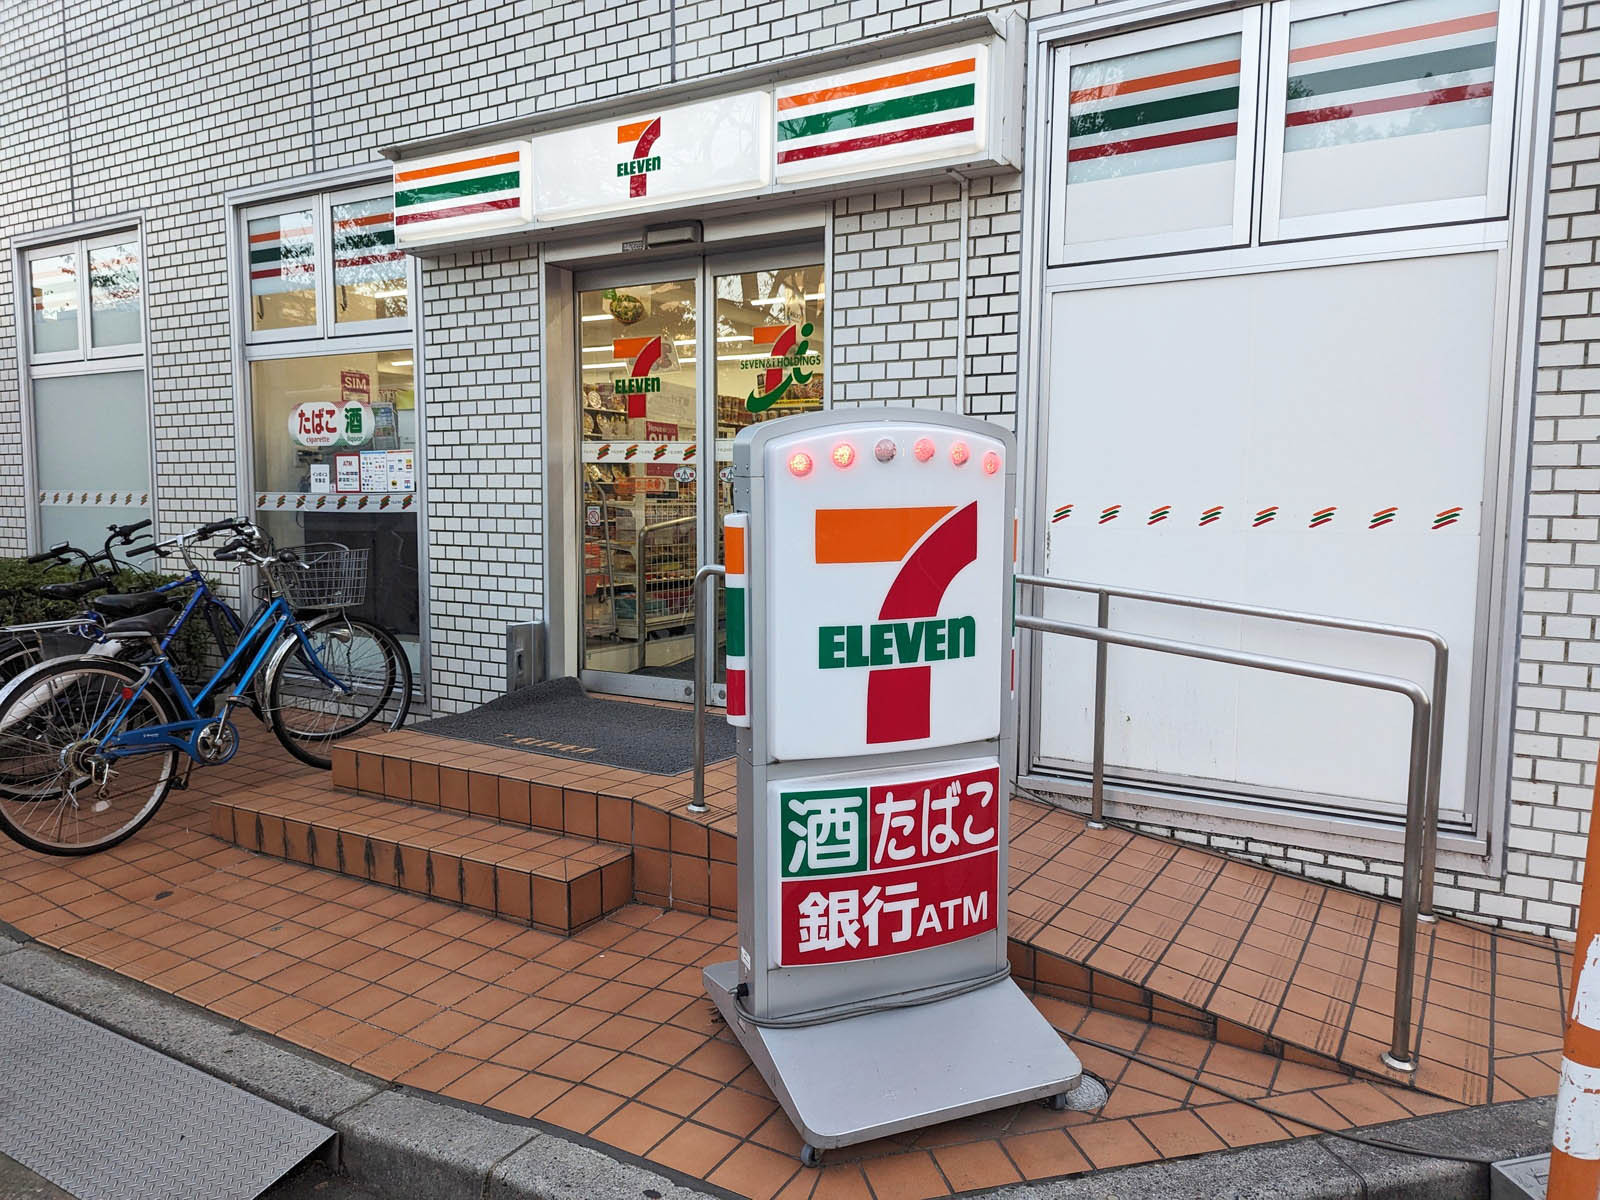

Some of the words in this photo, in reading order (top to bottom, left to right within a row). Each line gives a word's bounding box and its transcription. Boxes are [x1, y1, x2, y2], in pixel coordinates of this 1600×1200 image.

[617, 116, 661, 198] 7
[777, 355, 821, 368] HOLDINGS
[344, 376, 366, 390] SIM
[613, 336, 661, 418] 7
[298, 408, 337, 434] たばこ
[344, 407, 362, 434] 酒
[306, 435, 330, 444] cigarette
[815, 500, 977, 744] 7
[788, 796, 863, 873] 酒
[874, 780, 995, 864] たばこ
